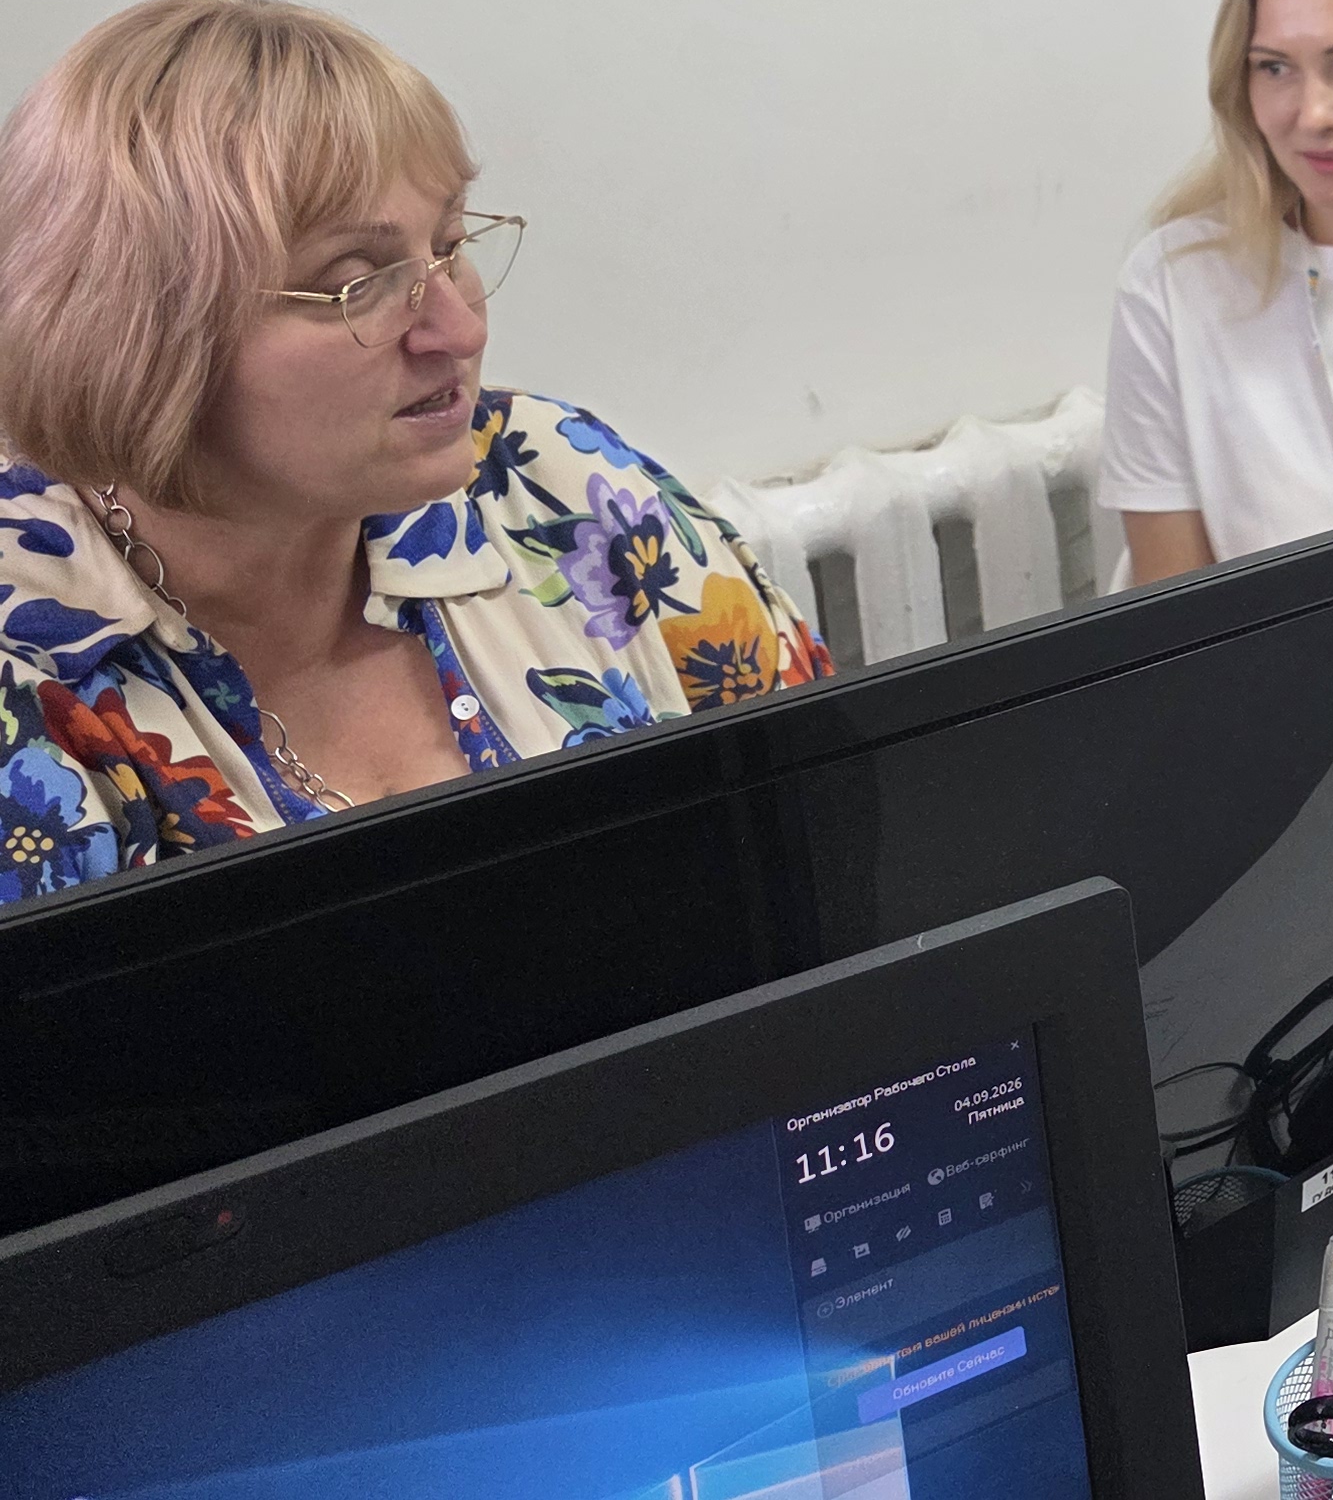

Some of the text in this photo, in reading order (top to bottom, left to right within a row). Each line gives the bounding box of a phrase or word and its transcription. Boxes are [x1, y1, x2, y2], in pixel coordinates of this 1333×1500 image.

[787, 1055, 977, 1131] Организатор Рабочего Стола
[954, 1077, 1023, 1111] 04.09.2026
[968, 1096, 1025, 1125] Пятница
[795, 1121, 896, 1184] 11:16
[823, 1183, 912, 1224] Организация
[835, 1278, 894, 1310] Элемент
[892, 1346, 1005, 1400] Обновите Сейчас
